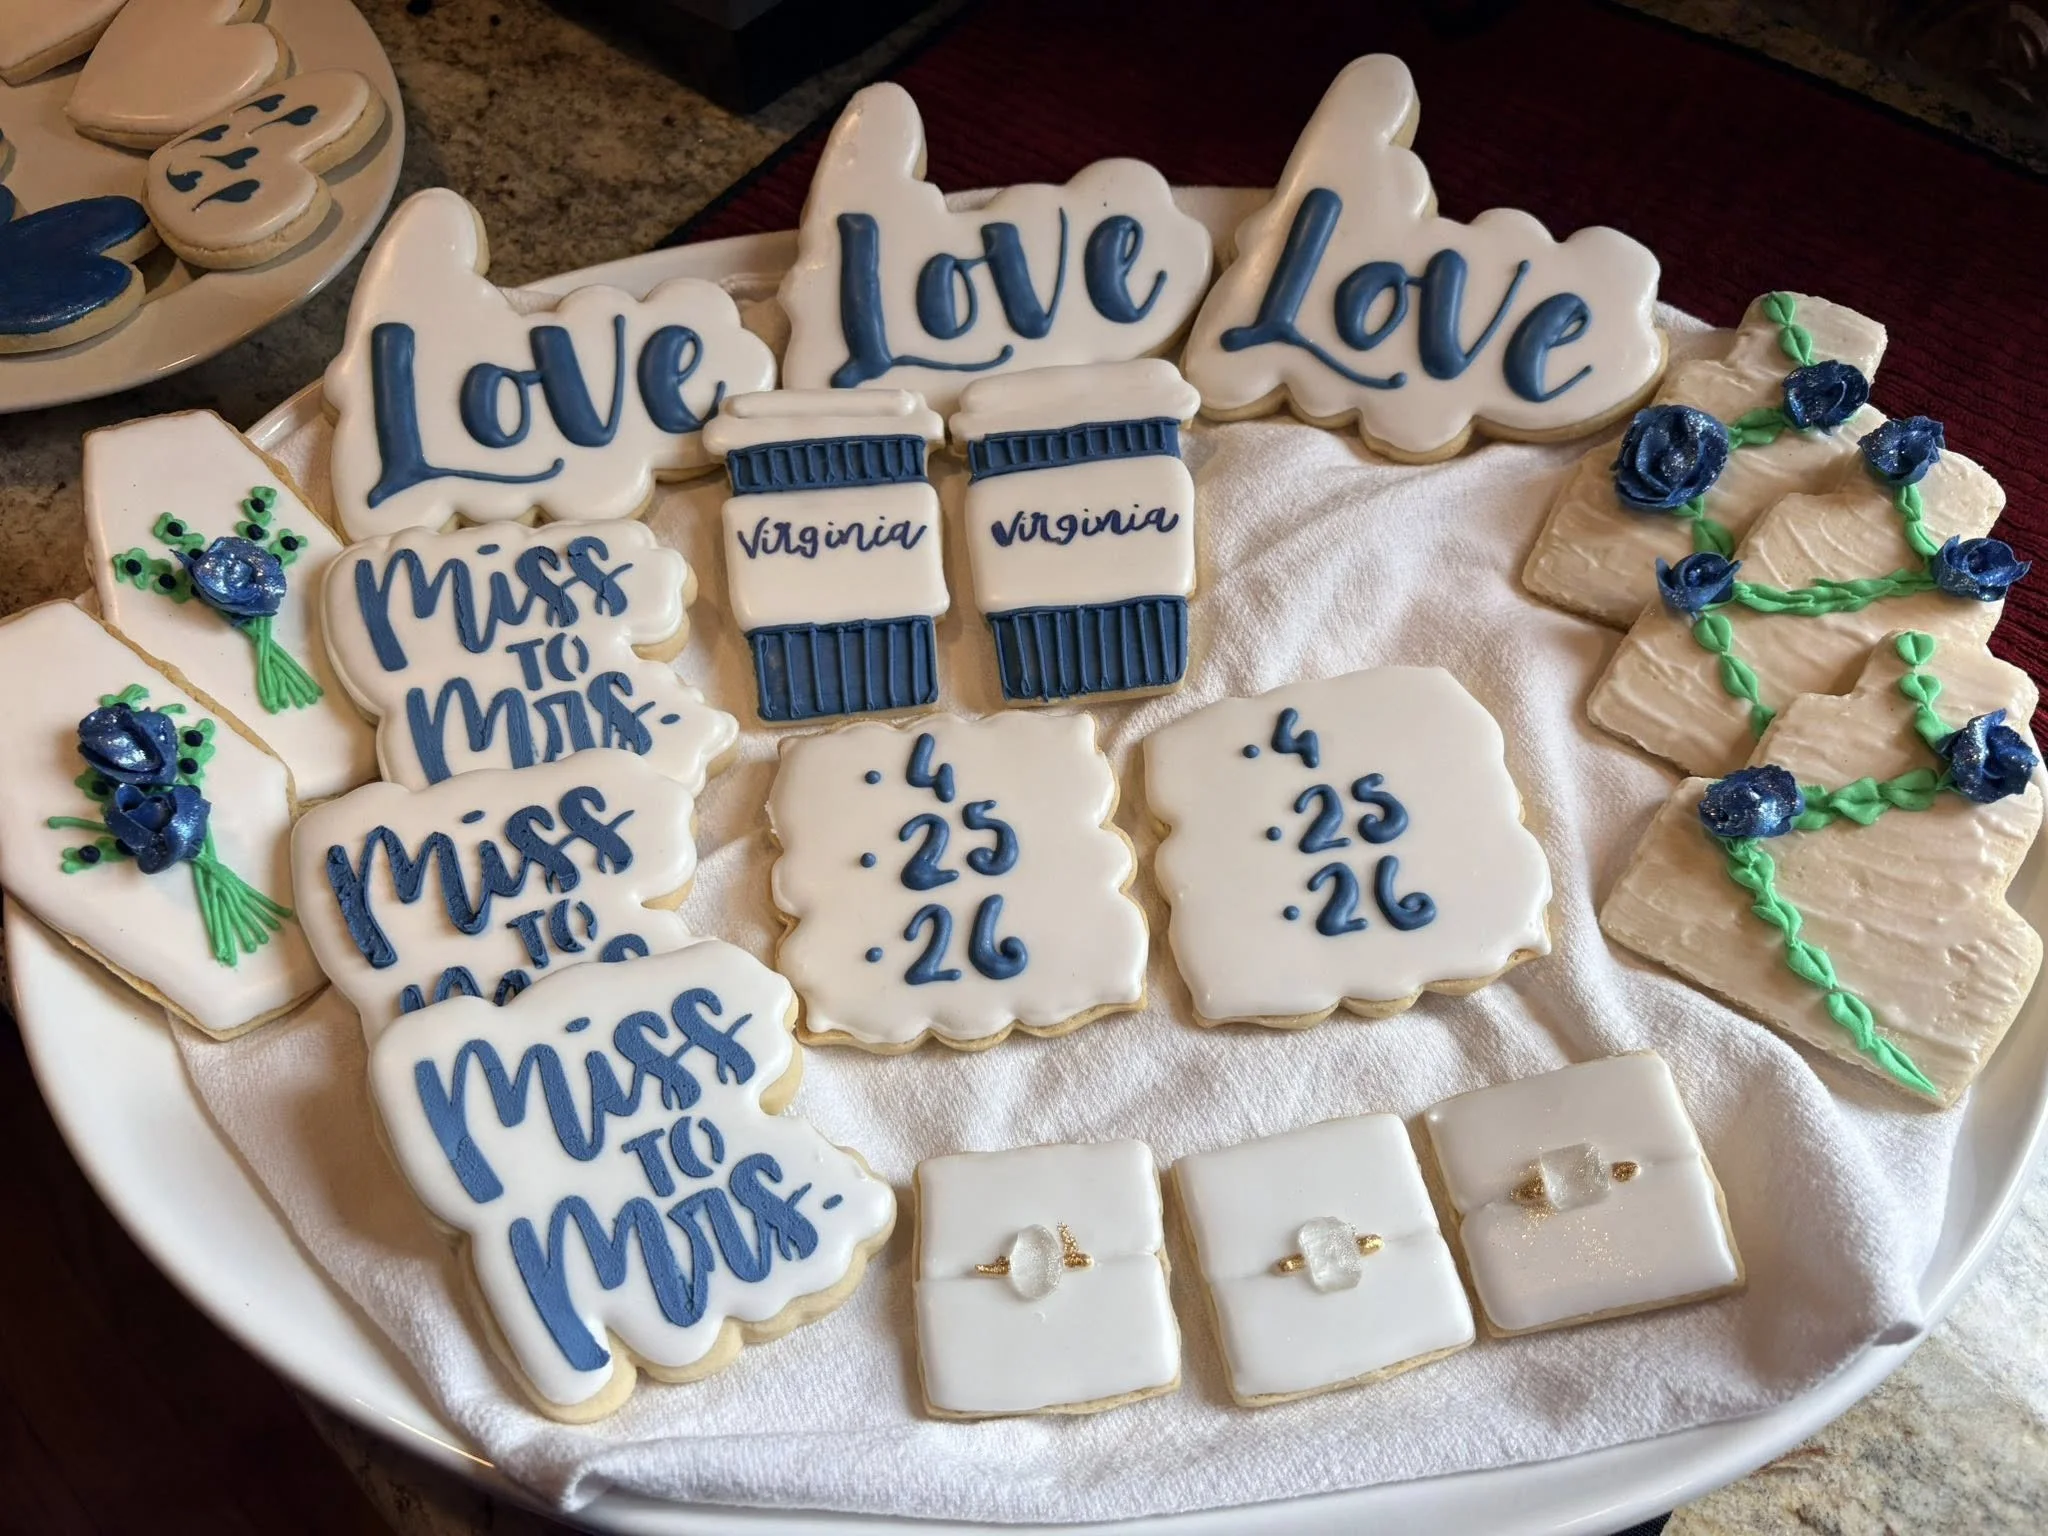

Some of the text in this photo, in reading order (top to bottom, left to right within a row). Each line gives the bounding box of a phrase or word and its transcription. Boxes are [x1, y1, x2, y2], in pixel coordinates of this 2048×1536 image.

[738, 516, 927, 559] Virginia
[991, 504, 1179, 547] Virginia
[355, 536, 634, 672] Miss
[326, 786, 635, 969] Miss
[414, 987, 753, 1204] Miss
